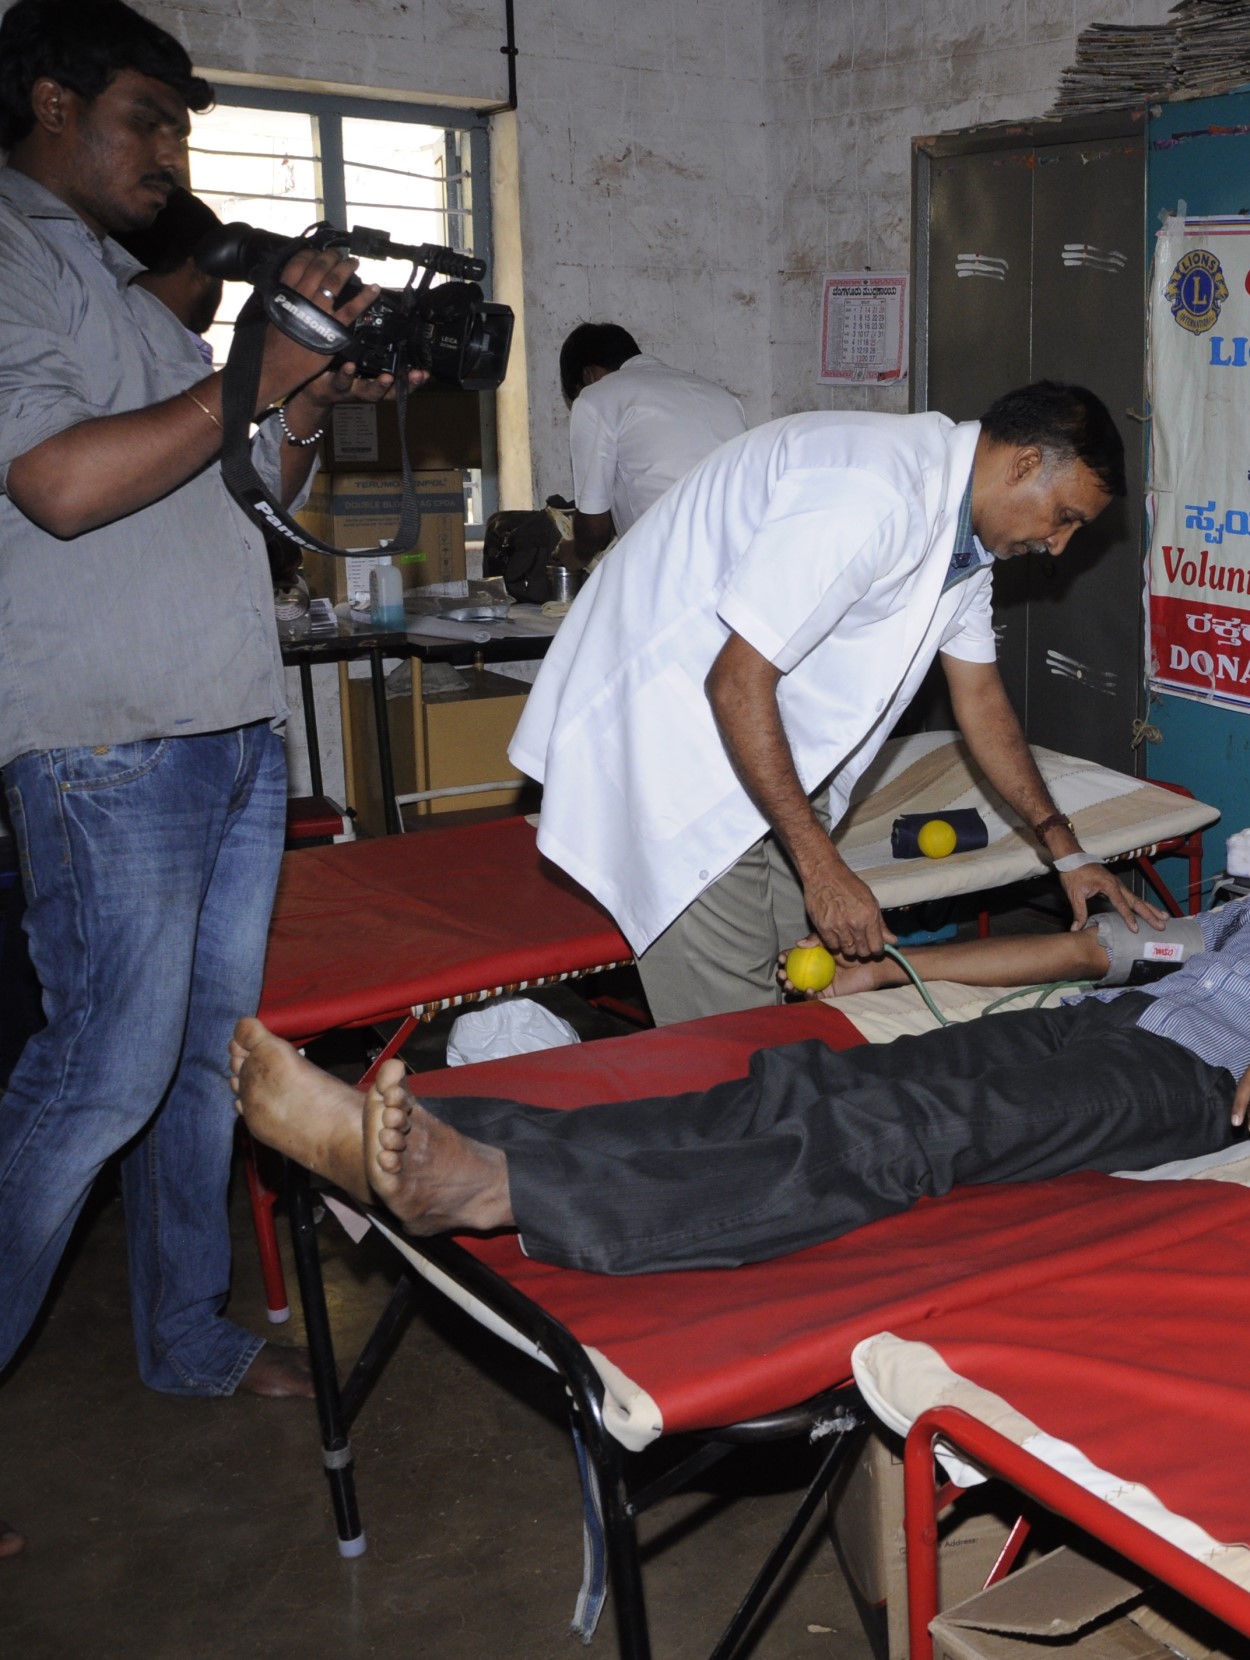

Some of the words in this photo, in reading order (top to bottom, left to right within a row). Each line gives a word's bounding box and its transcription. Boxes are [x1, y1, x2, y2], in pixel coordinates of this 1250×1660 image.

[1181, 253, 1216, 271] LIONS
[1192, 276, 1207, 305] L
[274, 294, 337, 342] Panasonic
